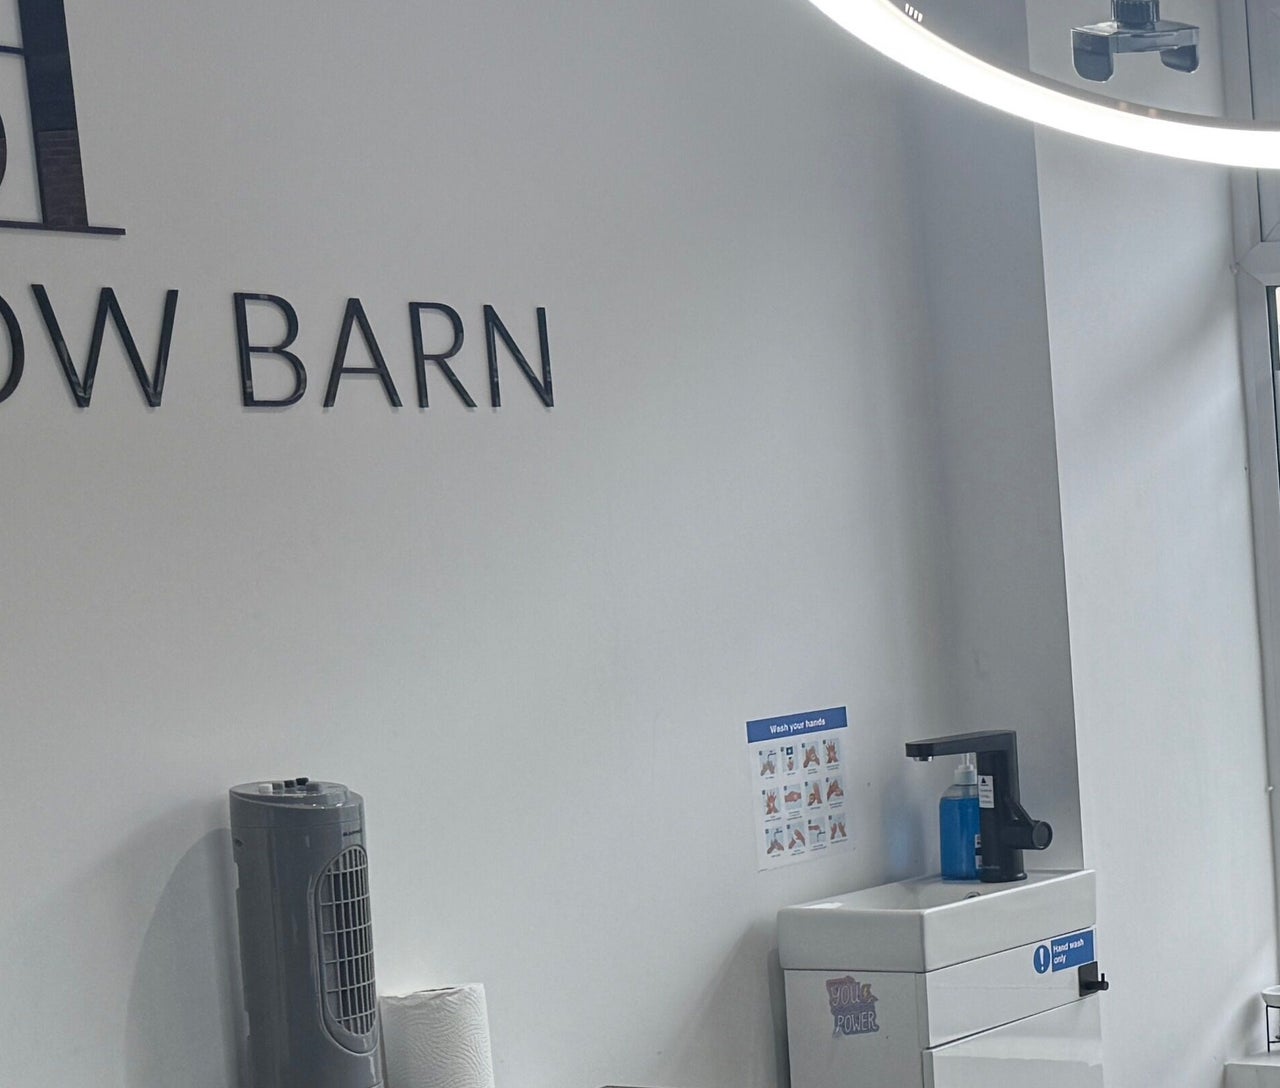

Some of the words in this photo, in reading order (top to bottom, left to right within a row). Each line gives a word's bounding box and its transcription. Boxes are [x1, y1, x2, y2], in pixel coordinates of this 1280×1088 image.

[234, 292, 555, 408] BARN
[769, 724, 789, 734] Wash
[790, 722, 805, 732] your
[805, 717, 826, 728] hands
[1053, 942, 1069, 954] Hand
[1069, 938, 1085, 949] wash
[1053, 954, 1067, 964] only
[836, 1010, 879, 1033] POWER
